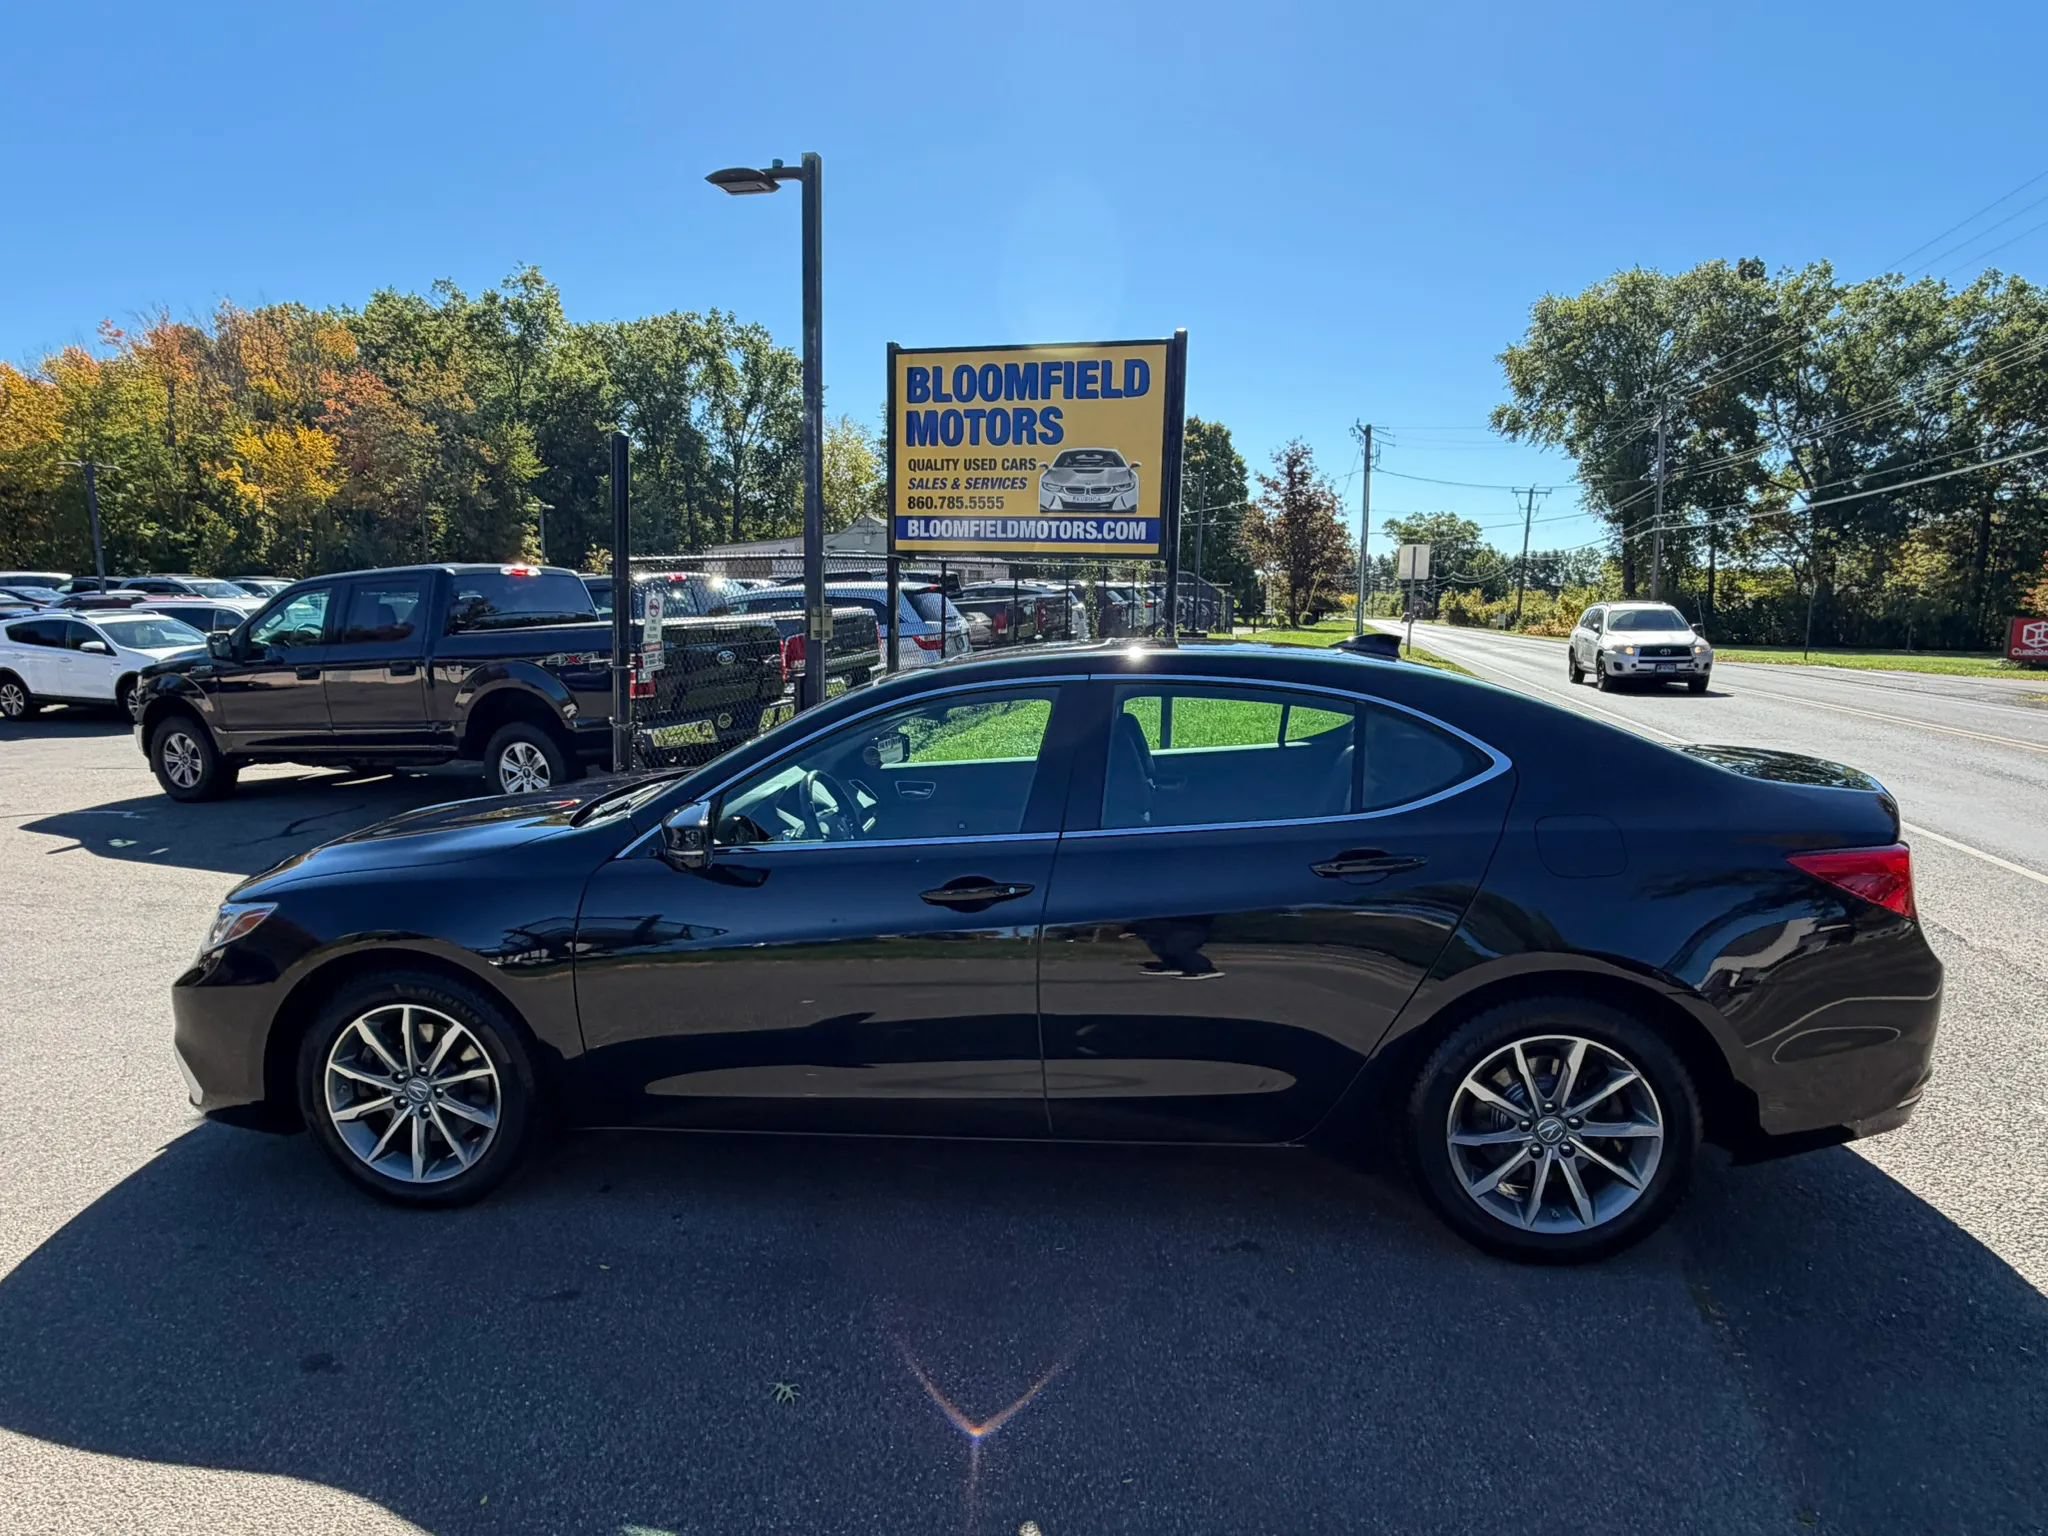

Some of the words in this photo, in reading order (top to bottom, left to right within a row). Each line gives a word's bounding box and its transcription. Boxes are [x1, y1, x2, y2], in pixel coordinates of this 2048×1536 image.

[907, 359, 1150, 404] BLOOMFIELD
[906, 407, 1064, 447] MOTORS
[908, 458, 959, 472] QUALITY
[963, 458, 997, 471] USED
[1001, 458, 1037, 471] CARS
[908, 477, 948, 490] SALES
[951, 477, 961, 490] &
[965, 477, 1027, 490] SERVICES
[908, 496, 1004, 510] 860.785.5555
[907, 519, 1147, 541] BLOOMFIELDMOTORS.COM
